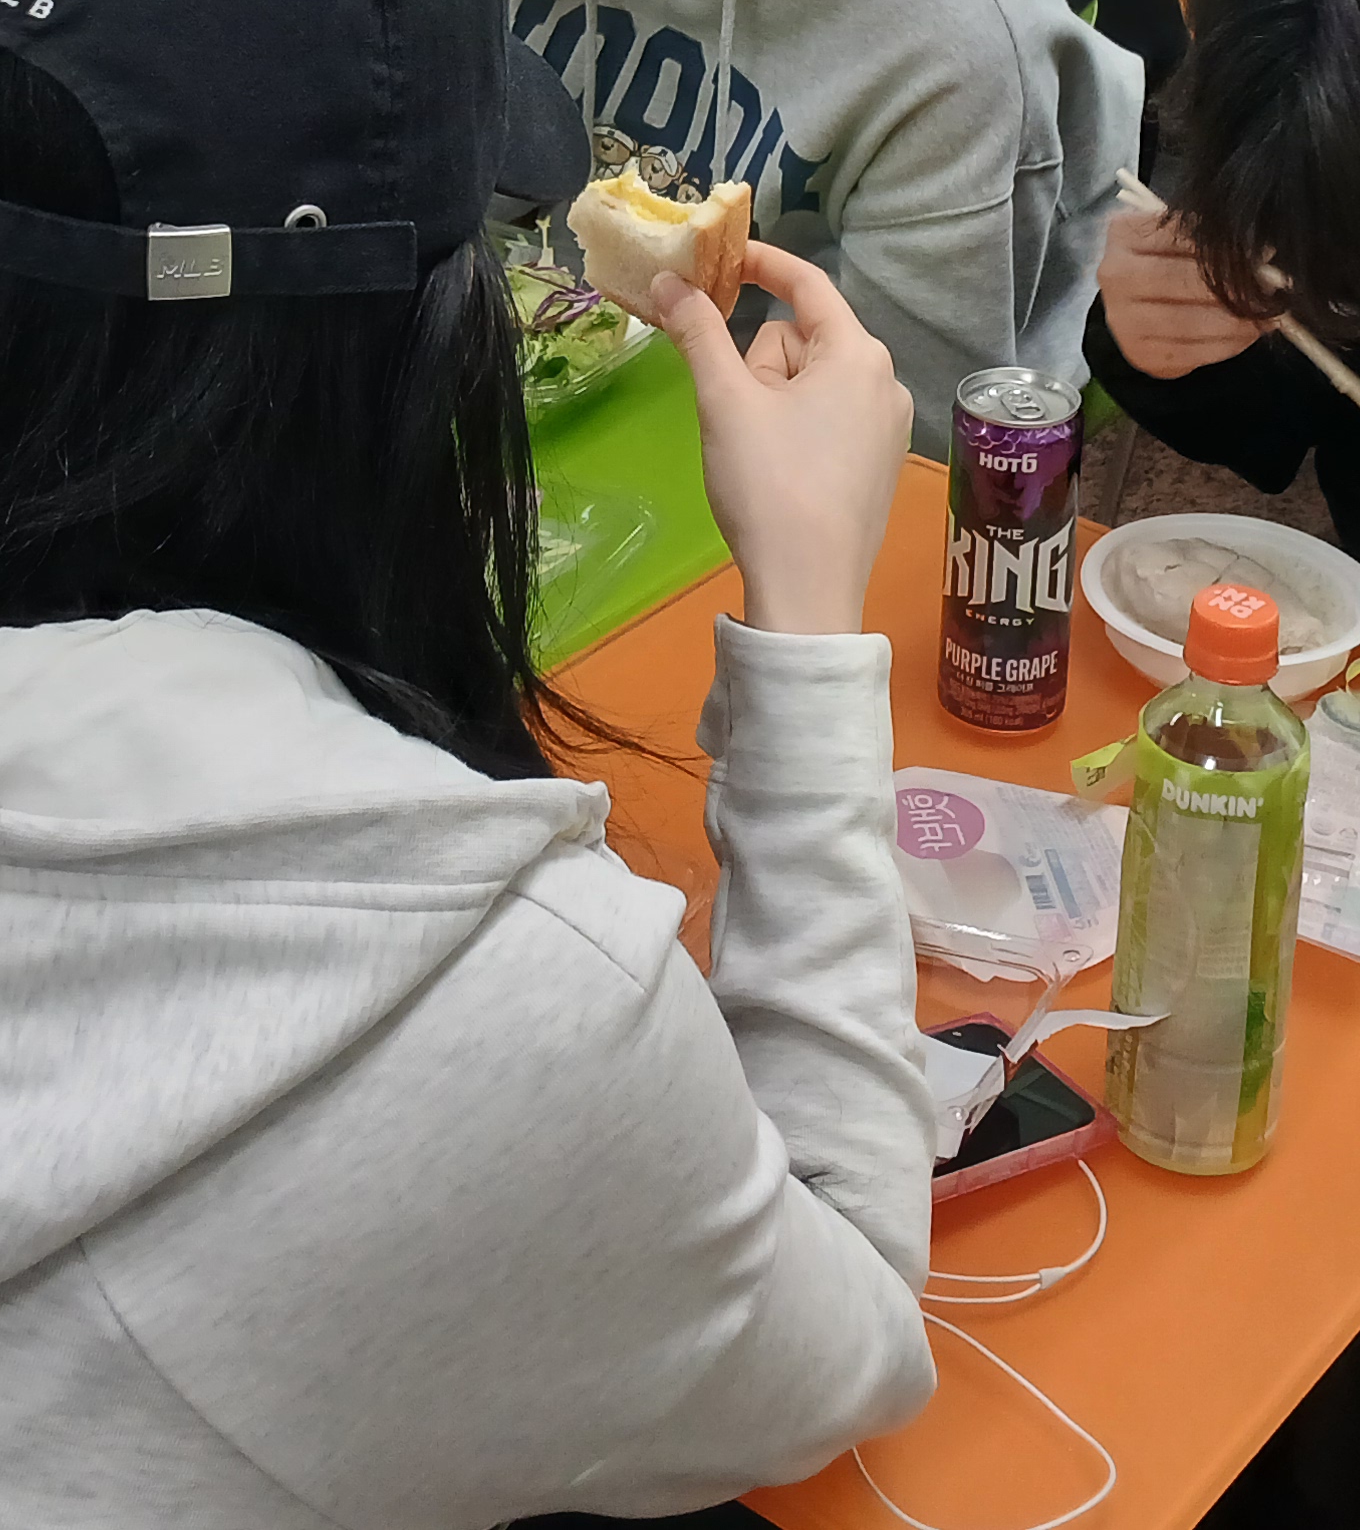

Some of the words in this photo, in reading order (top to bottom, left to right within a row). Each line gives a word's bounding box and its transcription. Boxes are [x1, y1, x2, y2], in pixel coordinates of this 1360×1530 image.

[979, 451, 1038, 474] HOT6
[985, 524, 1024, 540] THE
[942, 504, 1074, 614] KING
[965, 608, 1035, 627] ENERGY
[945, 637, 1002, 681] PURPLE
[1005, 650, 1058, 682] GRAPE
[1161, 778, 1264, 819] DUNKIN'
